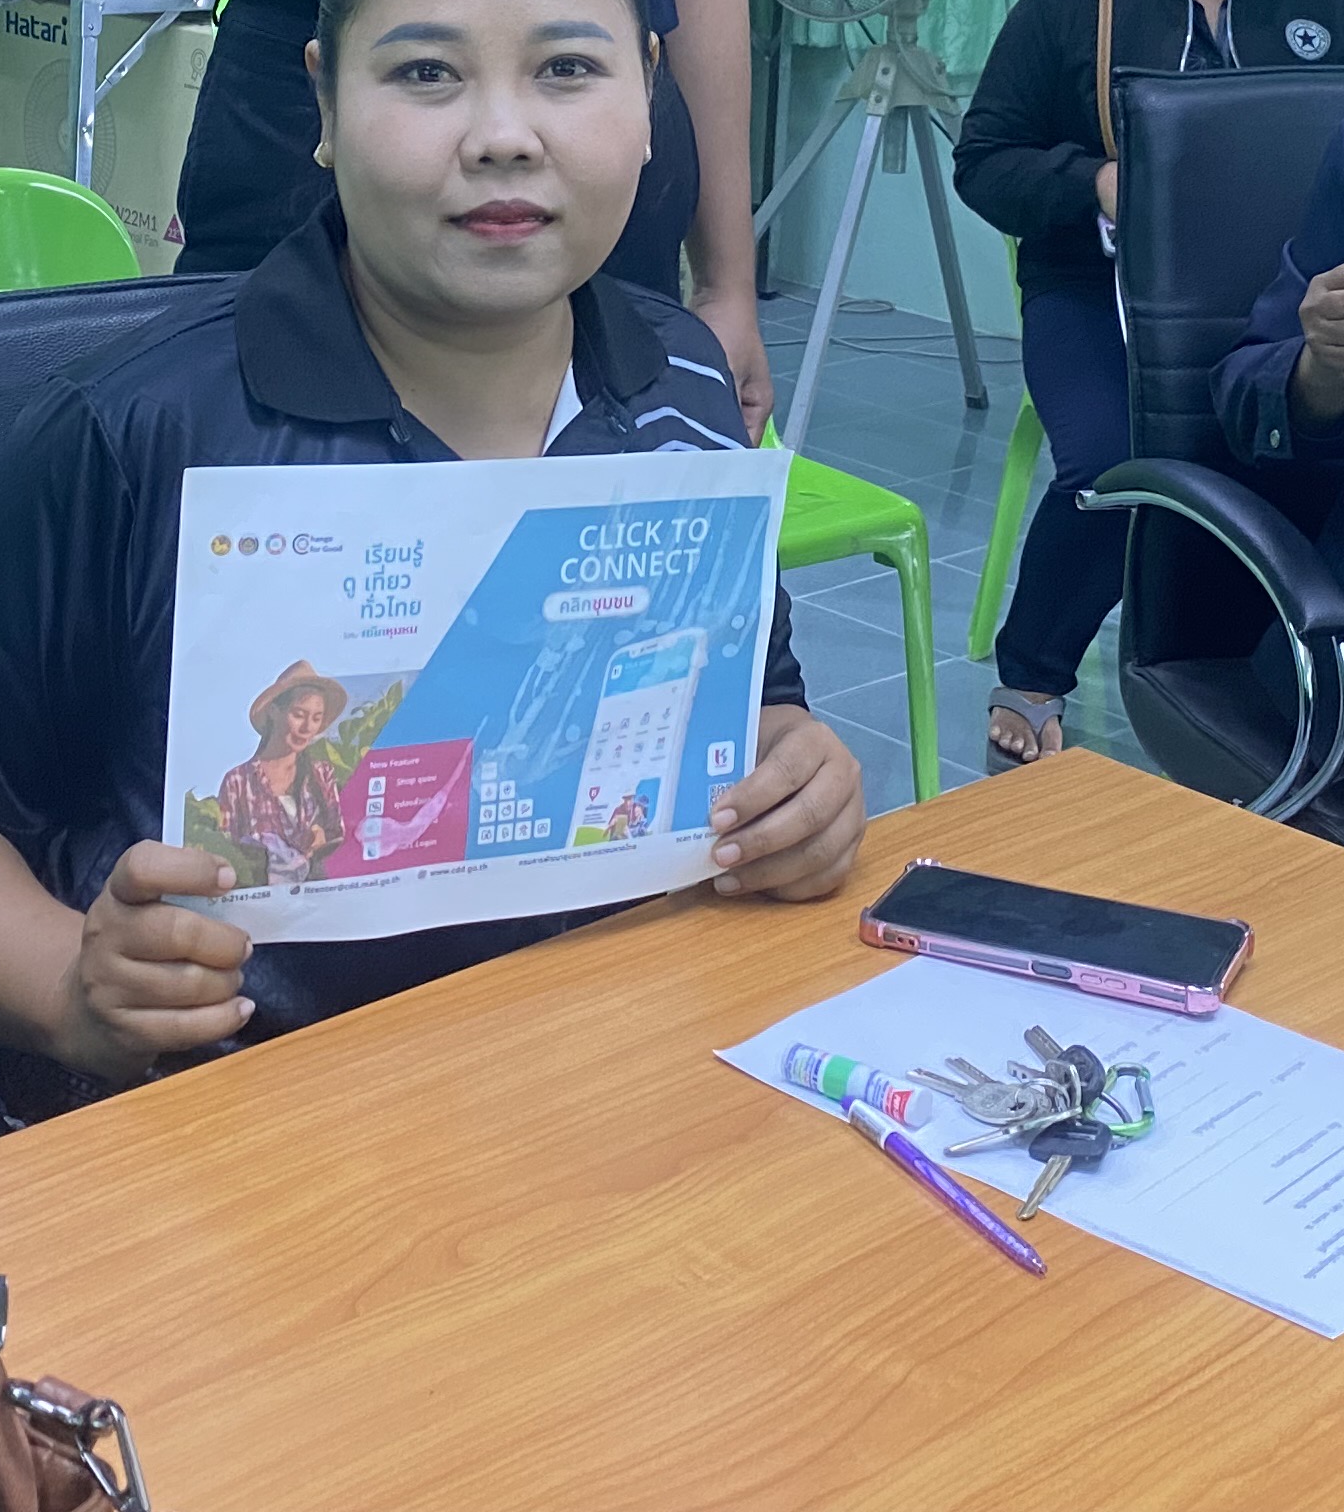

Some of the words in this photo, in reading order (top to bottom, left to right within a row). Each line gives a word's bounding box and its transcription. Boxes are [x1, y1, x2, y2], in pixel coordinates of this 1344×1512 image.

[6, 10, 68, 46] Hatari
[113, 204, 158, 233] N22M1
[579, 519, 663, 551] CLICK
[671, 517, 709, 543] TO
[365, 539, 425, 568] เรียนรู้
[560, 548, 701, 584] CONNECT
[342, 577, 356, 599] ดู
[365, 565, 412, 592] เที่ยว
[360, 592, 422, 619] ทั่วไทย
[559, 595, 634, 616] คลิกชุมชน
